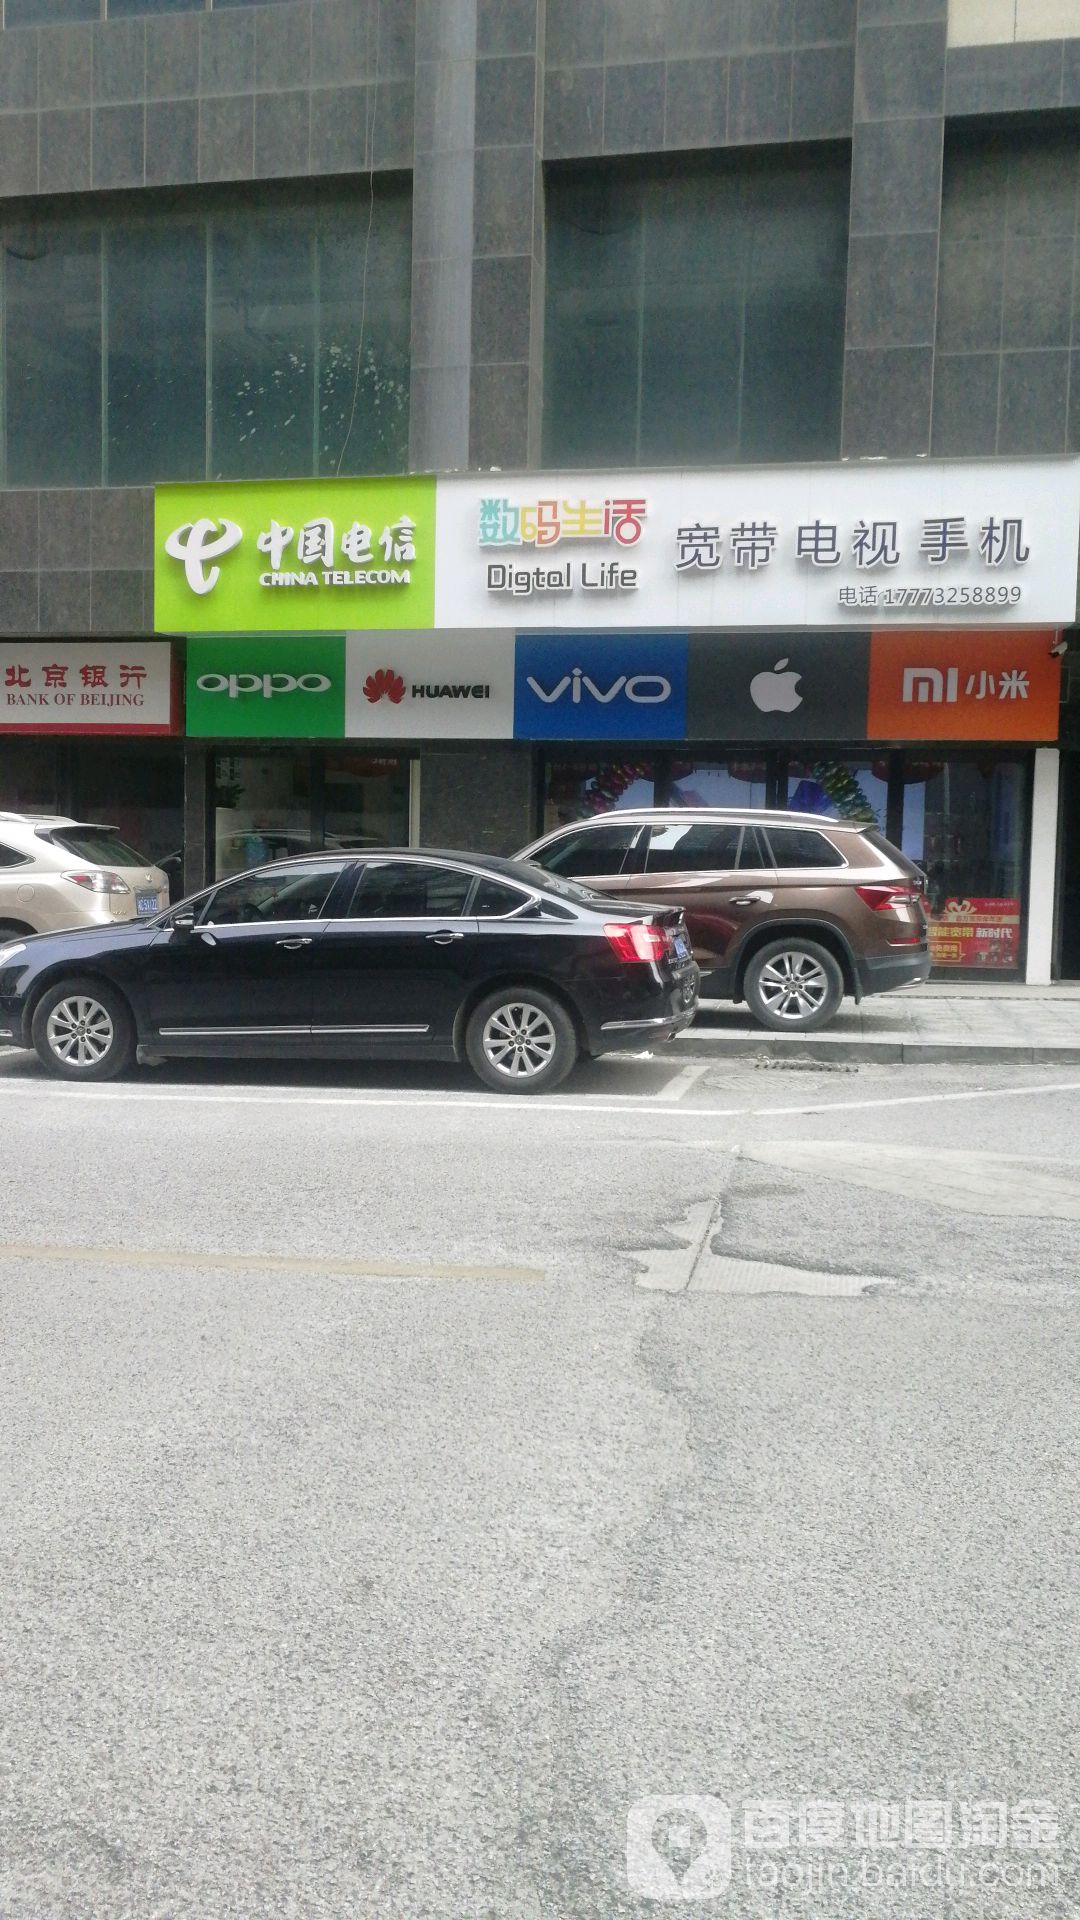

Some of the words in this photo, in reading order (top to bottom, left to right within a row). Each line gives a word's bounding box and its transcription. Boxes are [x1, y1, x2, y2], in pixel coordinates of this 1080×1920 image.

[479, 499, 646, 545] 数码生活
[256, 515, 417, 569] 中国电信
[675, 521, 777, 570] 宽带
[796, 519, 900, 567] 电视
[920, 516, 1030, 564] 手机
[259, 571, 319, 587] CHINA
[322, 569, 411, 586] TELECOM
[487, 562, 571, 594] Digtal
[581, 561, 638, 588] Life
[884, 586, 1021, 605] 17773258899
[5, 663, 147, 689] 北京银行
[964, 669, 1030, 700] 小米
[7, 693, 50, 706] BANK
[54, 693, 75, 706] OF
[80, 693, 145, 707] BEIJING
[411, 684, 490, 699] HUAWEI
[975, 927, 1013, 939] 新时代
